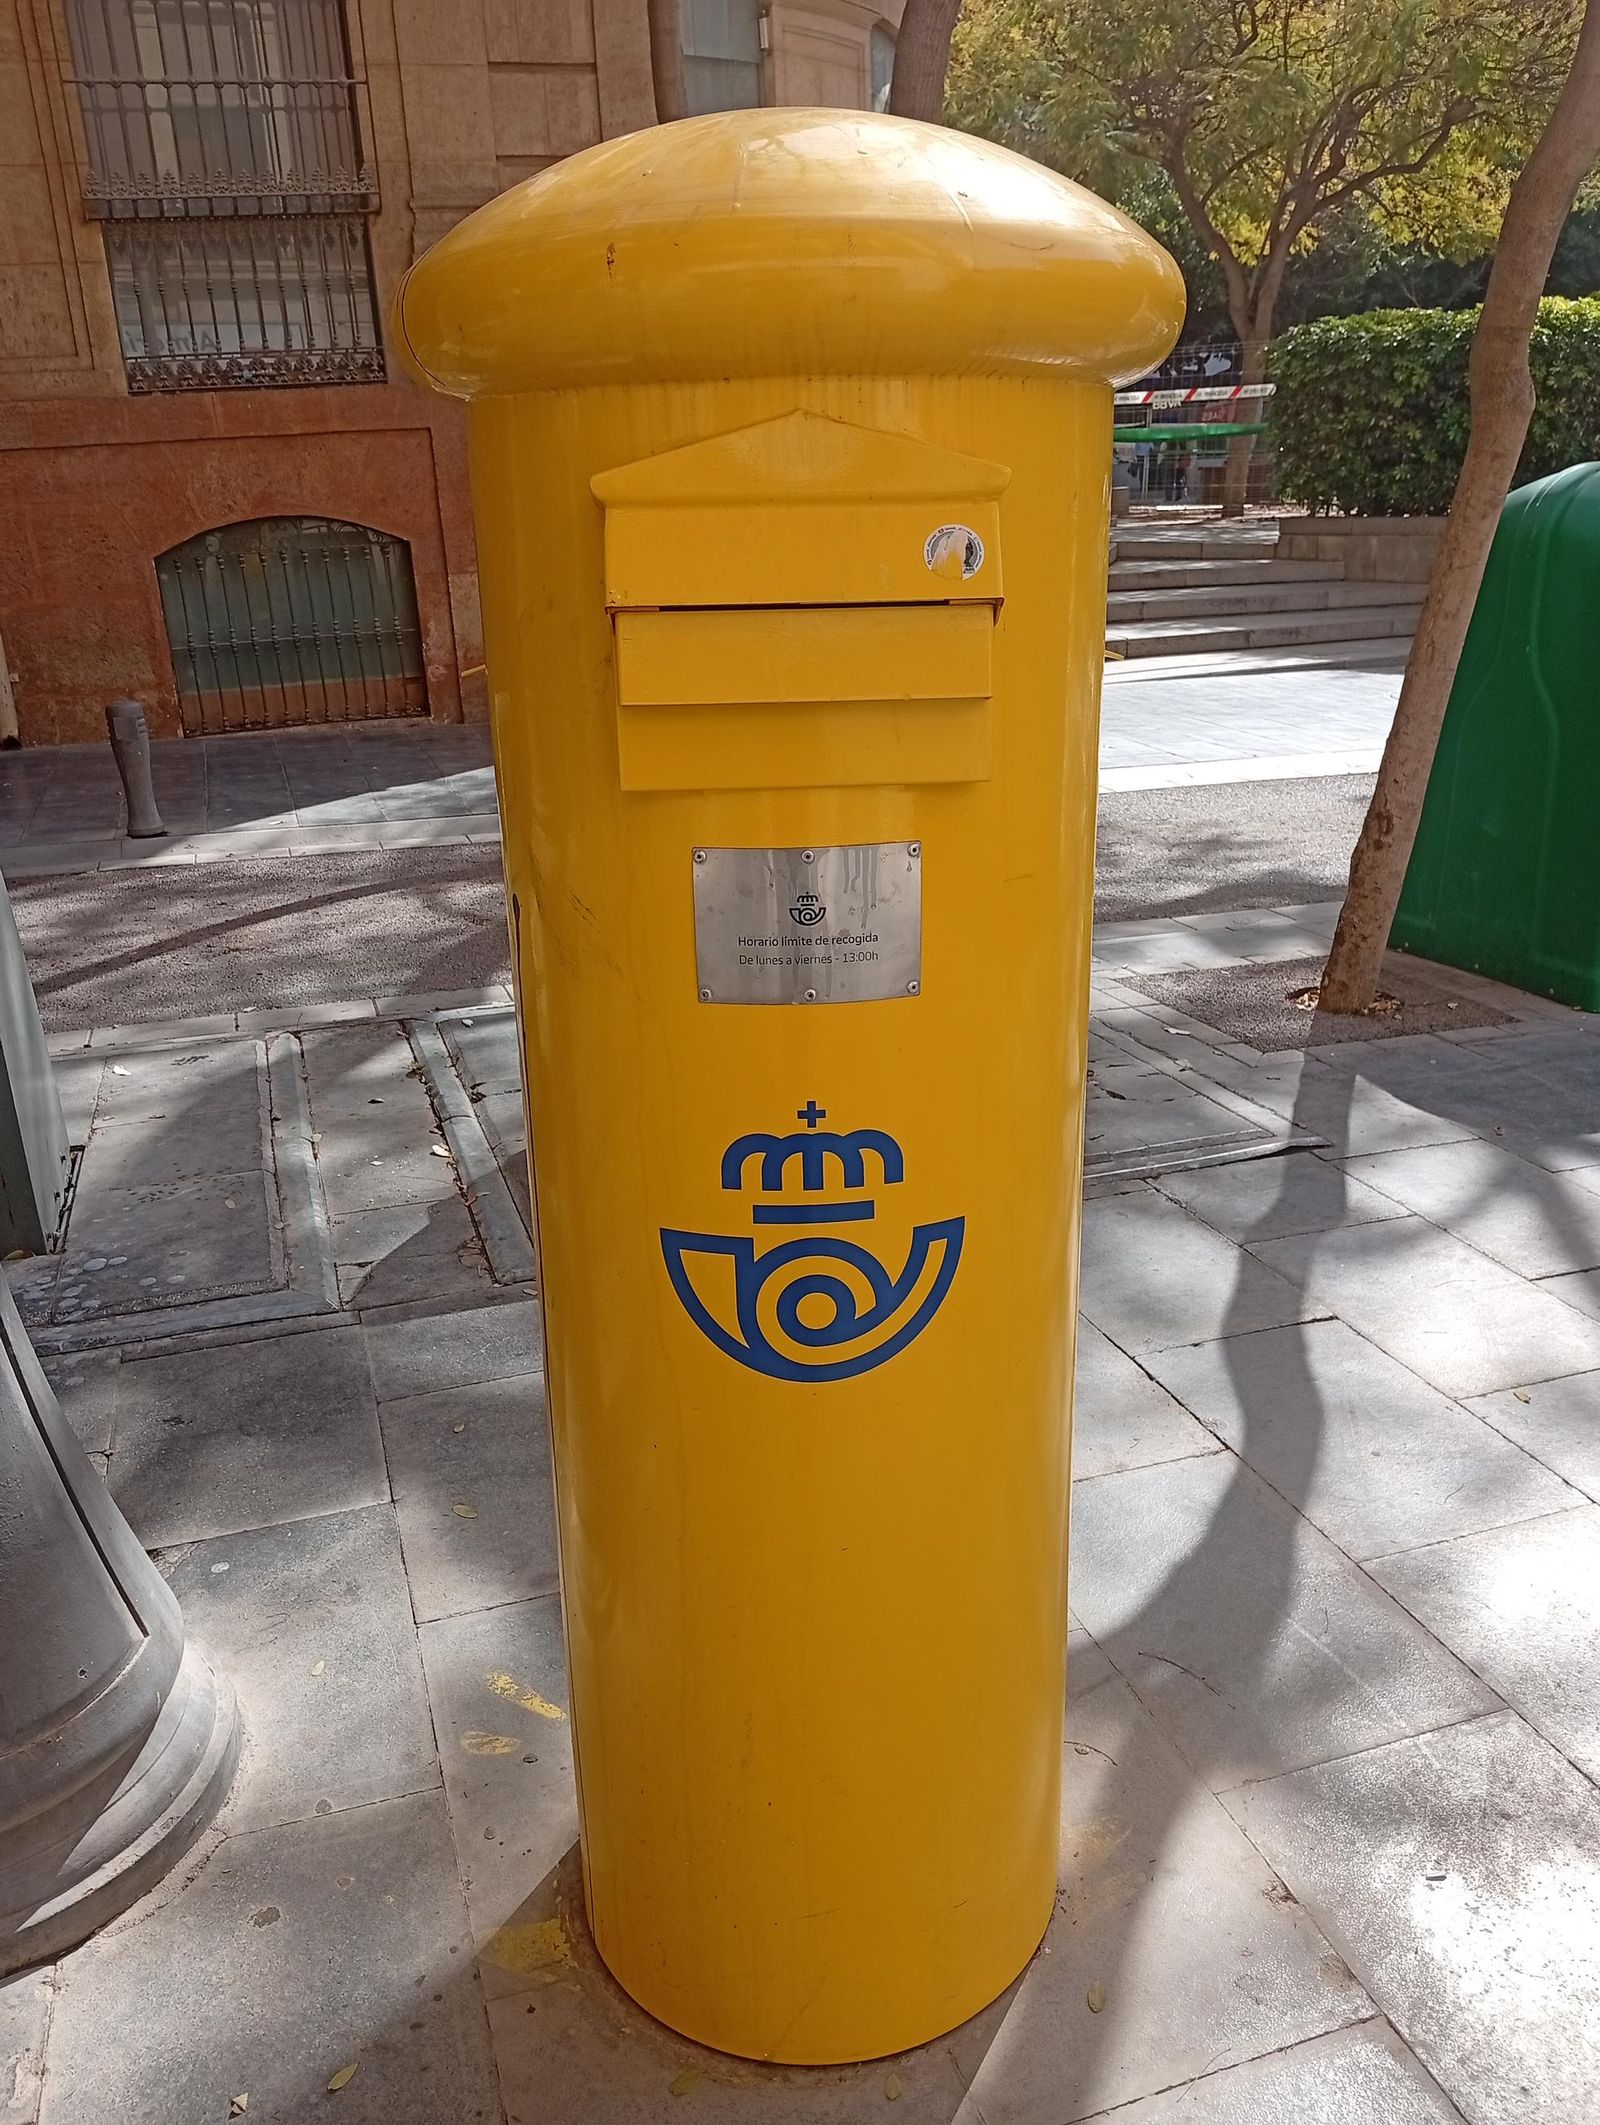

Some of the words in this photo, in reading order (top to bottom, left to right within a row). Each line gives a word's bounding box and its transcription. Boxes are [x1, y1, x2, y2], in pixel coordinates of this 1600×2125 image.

[738, 936, 779, 947] Horario
[781, 935, 813, 946] límite
[815, 935, 829, 945] de
[831, 932, 879, 946] recogida
[739, 954, 754, 965] De
[756, 954, 784, 965] lunes
[785, 957, 792, 965] a
[794, 954, 833, 965] viernes
[842, 950, 879, 963] 13:00h
